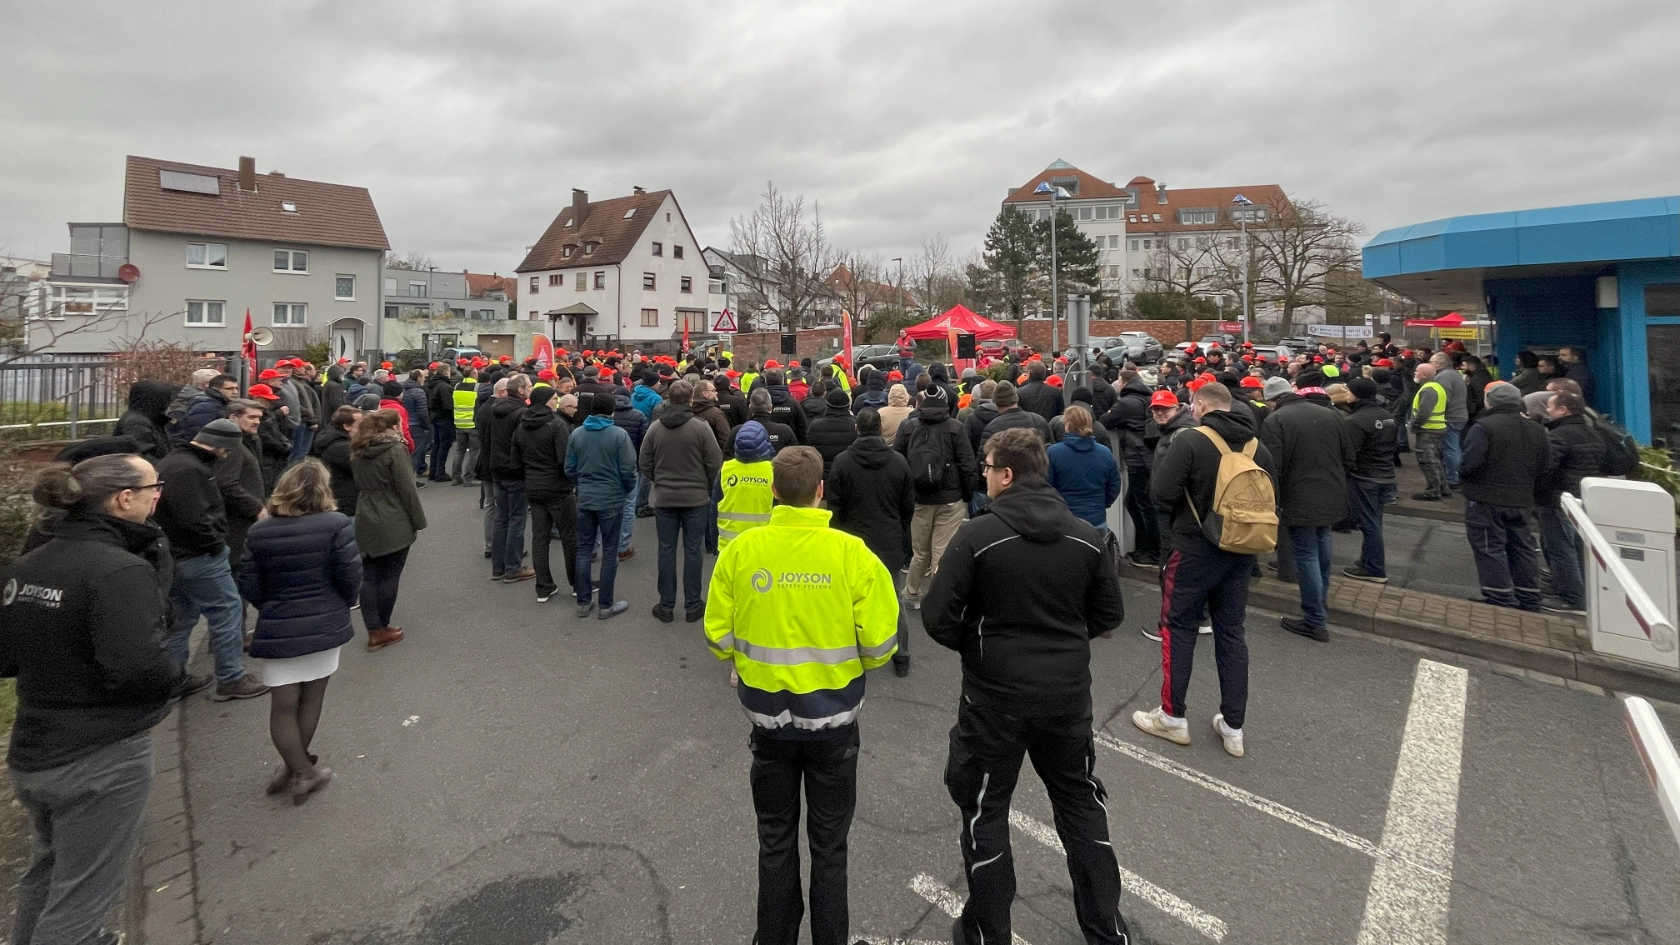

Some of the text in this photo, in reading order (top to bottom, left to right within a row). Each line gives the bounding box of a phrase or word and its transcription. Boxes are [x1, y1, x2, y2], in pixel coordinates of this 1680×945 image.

[740, 476, 768, 484] JOYSON
[778, 572, 832, 584] JOYSON
[19, 583, 63, 602] JOYSON
